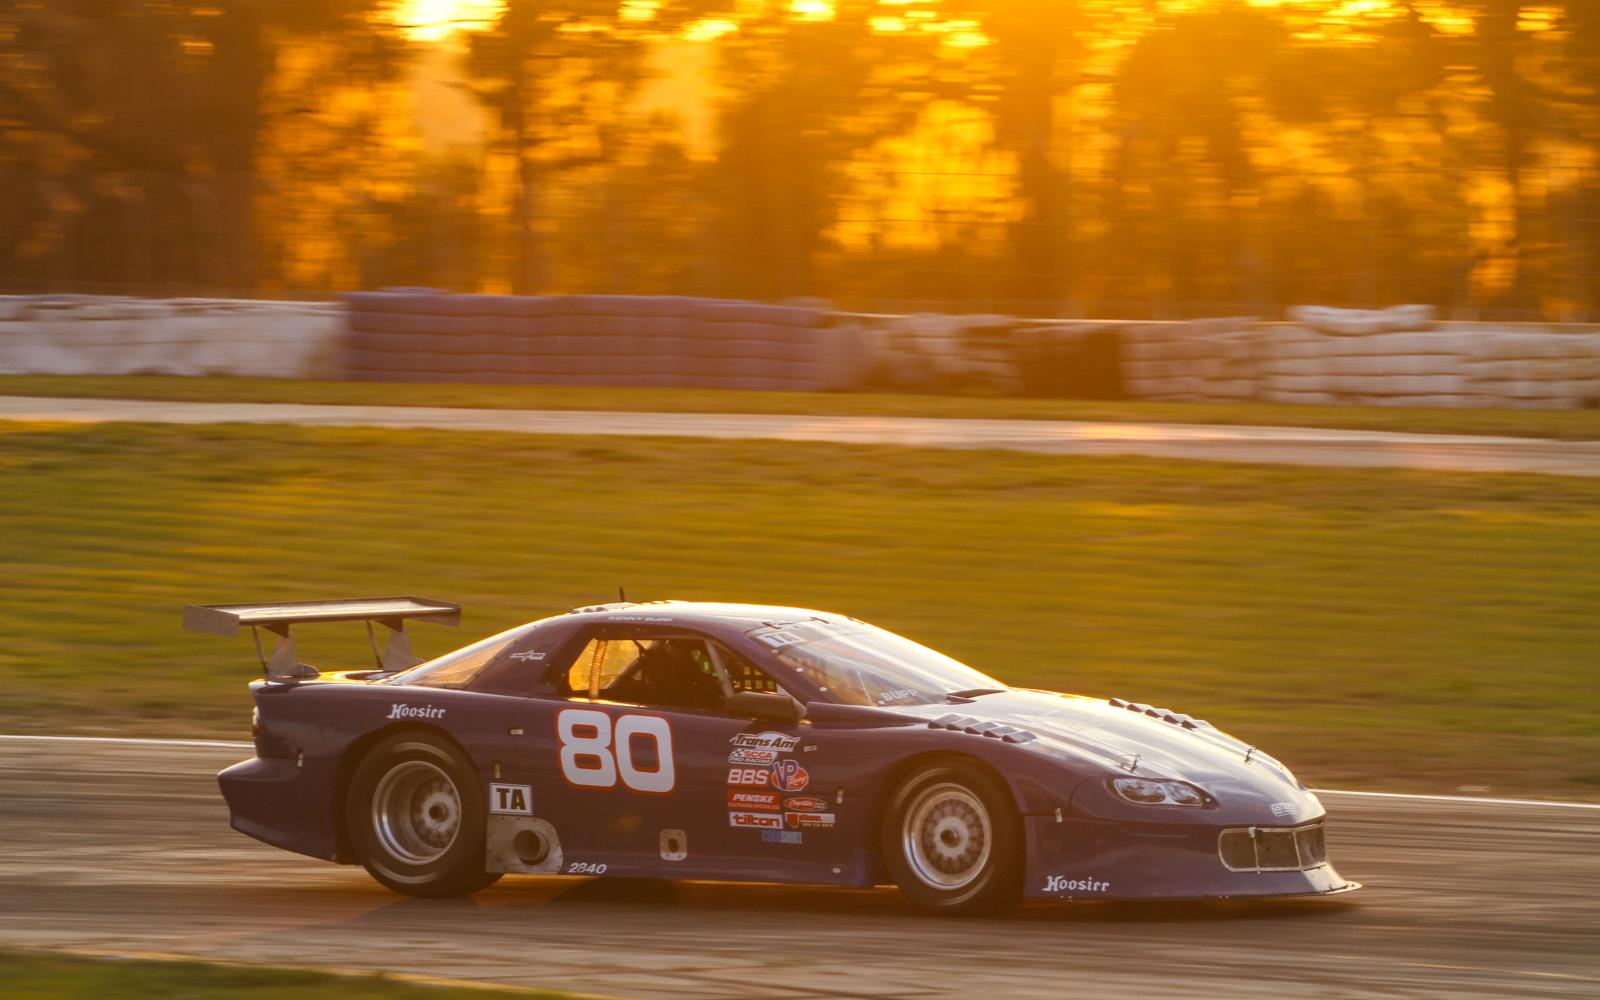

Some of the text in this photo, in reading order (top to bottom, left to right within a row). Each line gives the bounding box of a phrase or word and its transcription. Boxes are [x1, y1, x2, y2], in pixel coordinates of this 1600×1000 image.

[386, 703, 446, 719] Hoosier
[733, 734, 796, 749] Trans Am
[557, 708, 676, 794] 80
[743, 750, 773, 759] SCCA
[727, 768, 769, 785] BBS
[772, 760, 798, 791] VP
[496, 787, 527, 811] TA
[732, 793, 775, 803] PENSKE
[733, 813, 780, 827] tilton
[567, 862, 608, 875] 2840
[1041, 875, 1111, 893] Hoosier
